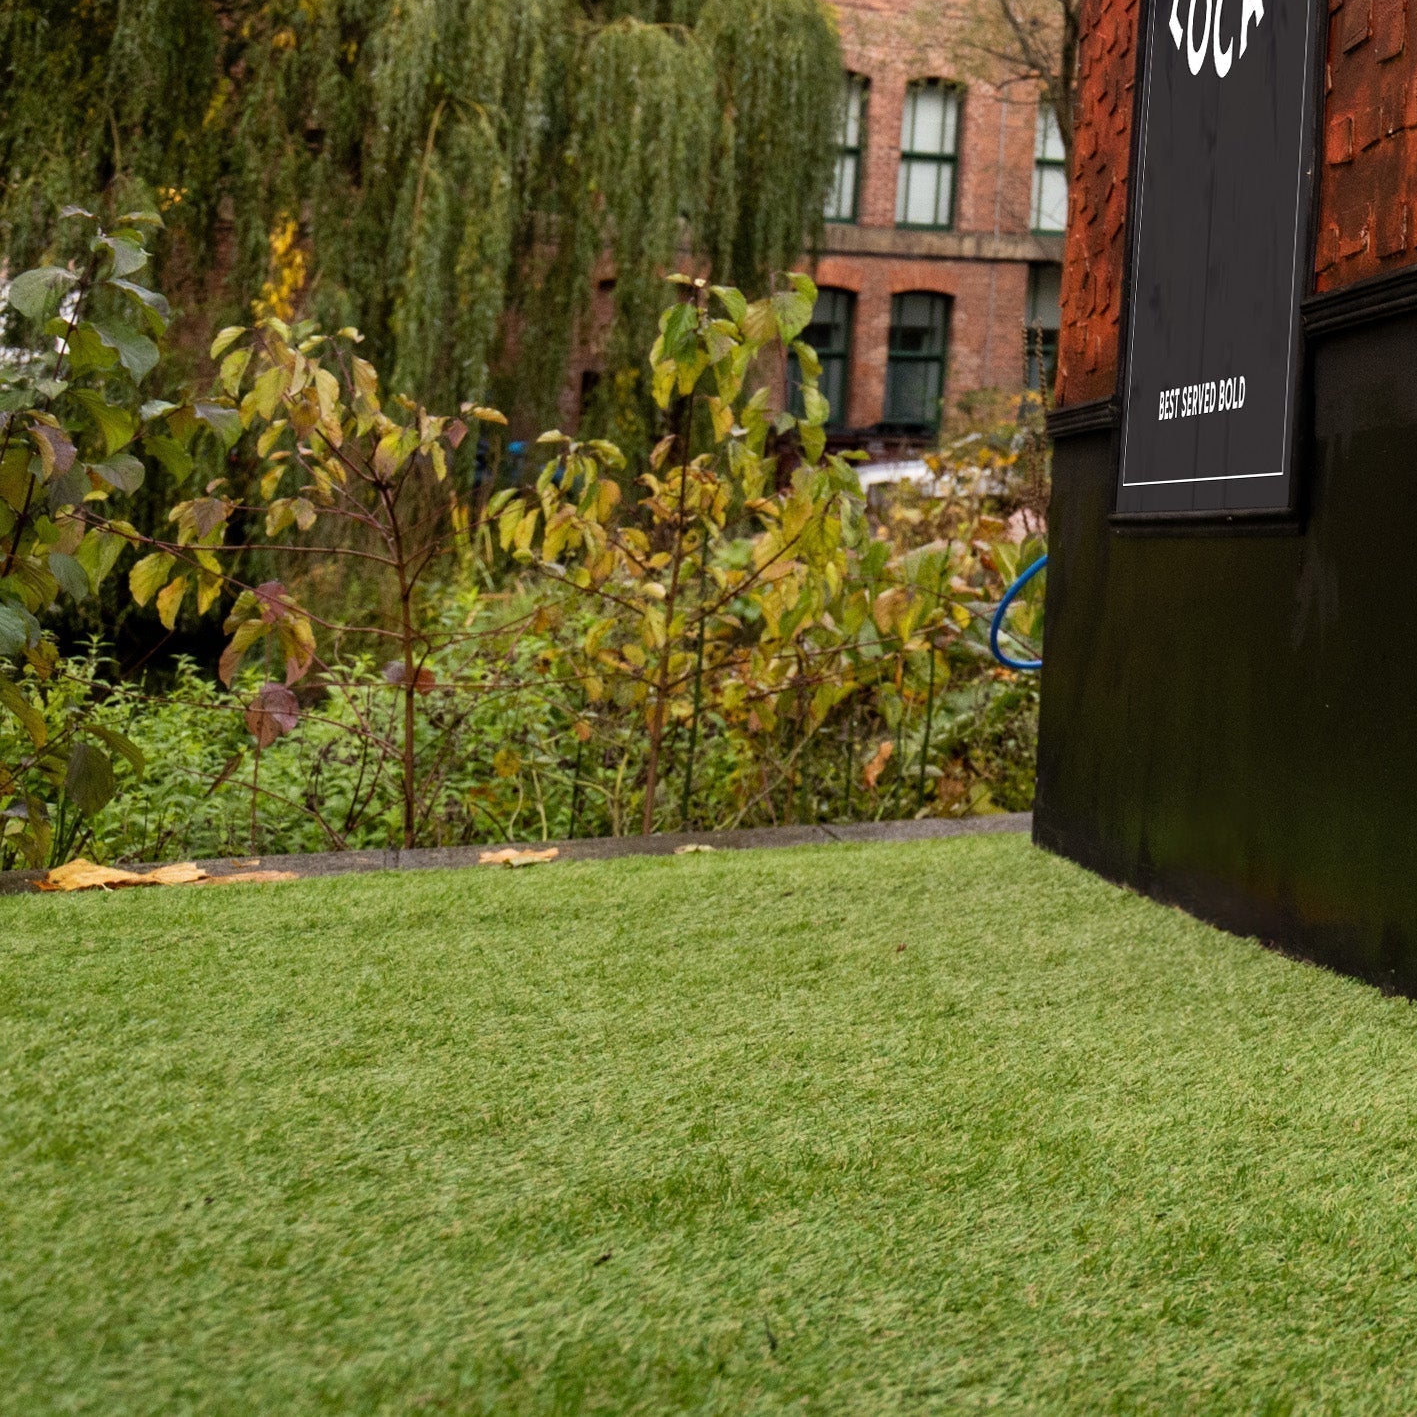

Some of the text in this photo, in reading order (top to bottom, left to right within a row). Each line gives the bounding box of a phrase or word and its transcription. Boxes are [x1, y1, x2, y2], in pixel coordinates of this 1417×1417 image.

[1158, 375, 1245, 420] BEST SERVED BOLD
